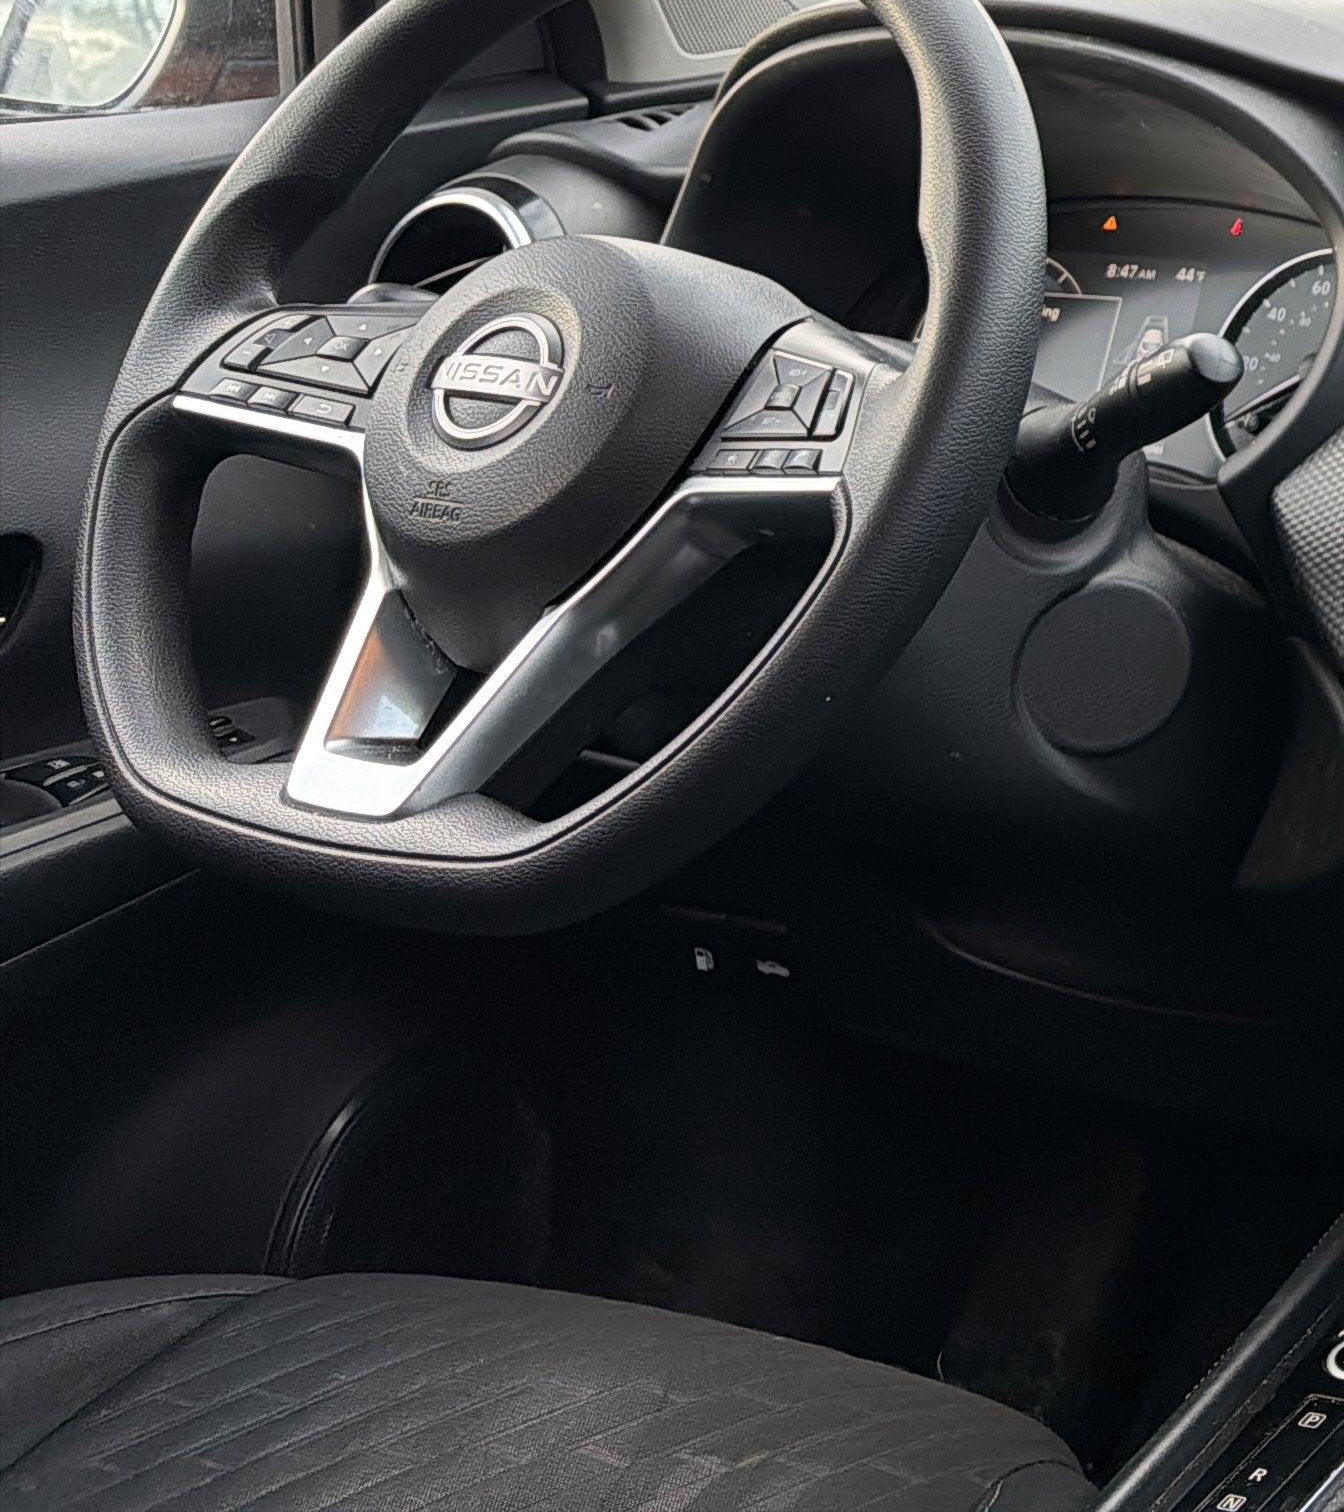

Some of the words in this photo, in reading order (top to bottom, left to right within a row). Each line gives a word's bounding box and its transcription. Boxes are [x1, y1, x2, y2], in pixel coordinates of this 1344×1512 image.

[1106, 263, 1139, 280] 8:47
[1312, 281, 1331, 295] 60
[1267, 307, 1287, 322] 40
[410, 500, 462, 523] AIRBAG
[1308, 1414, 1321, 1425] P
[1248, 1467, 1269, 1482] R
[1226, 1497, 1242, 1509] N
